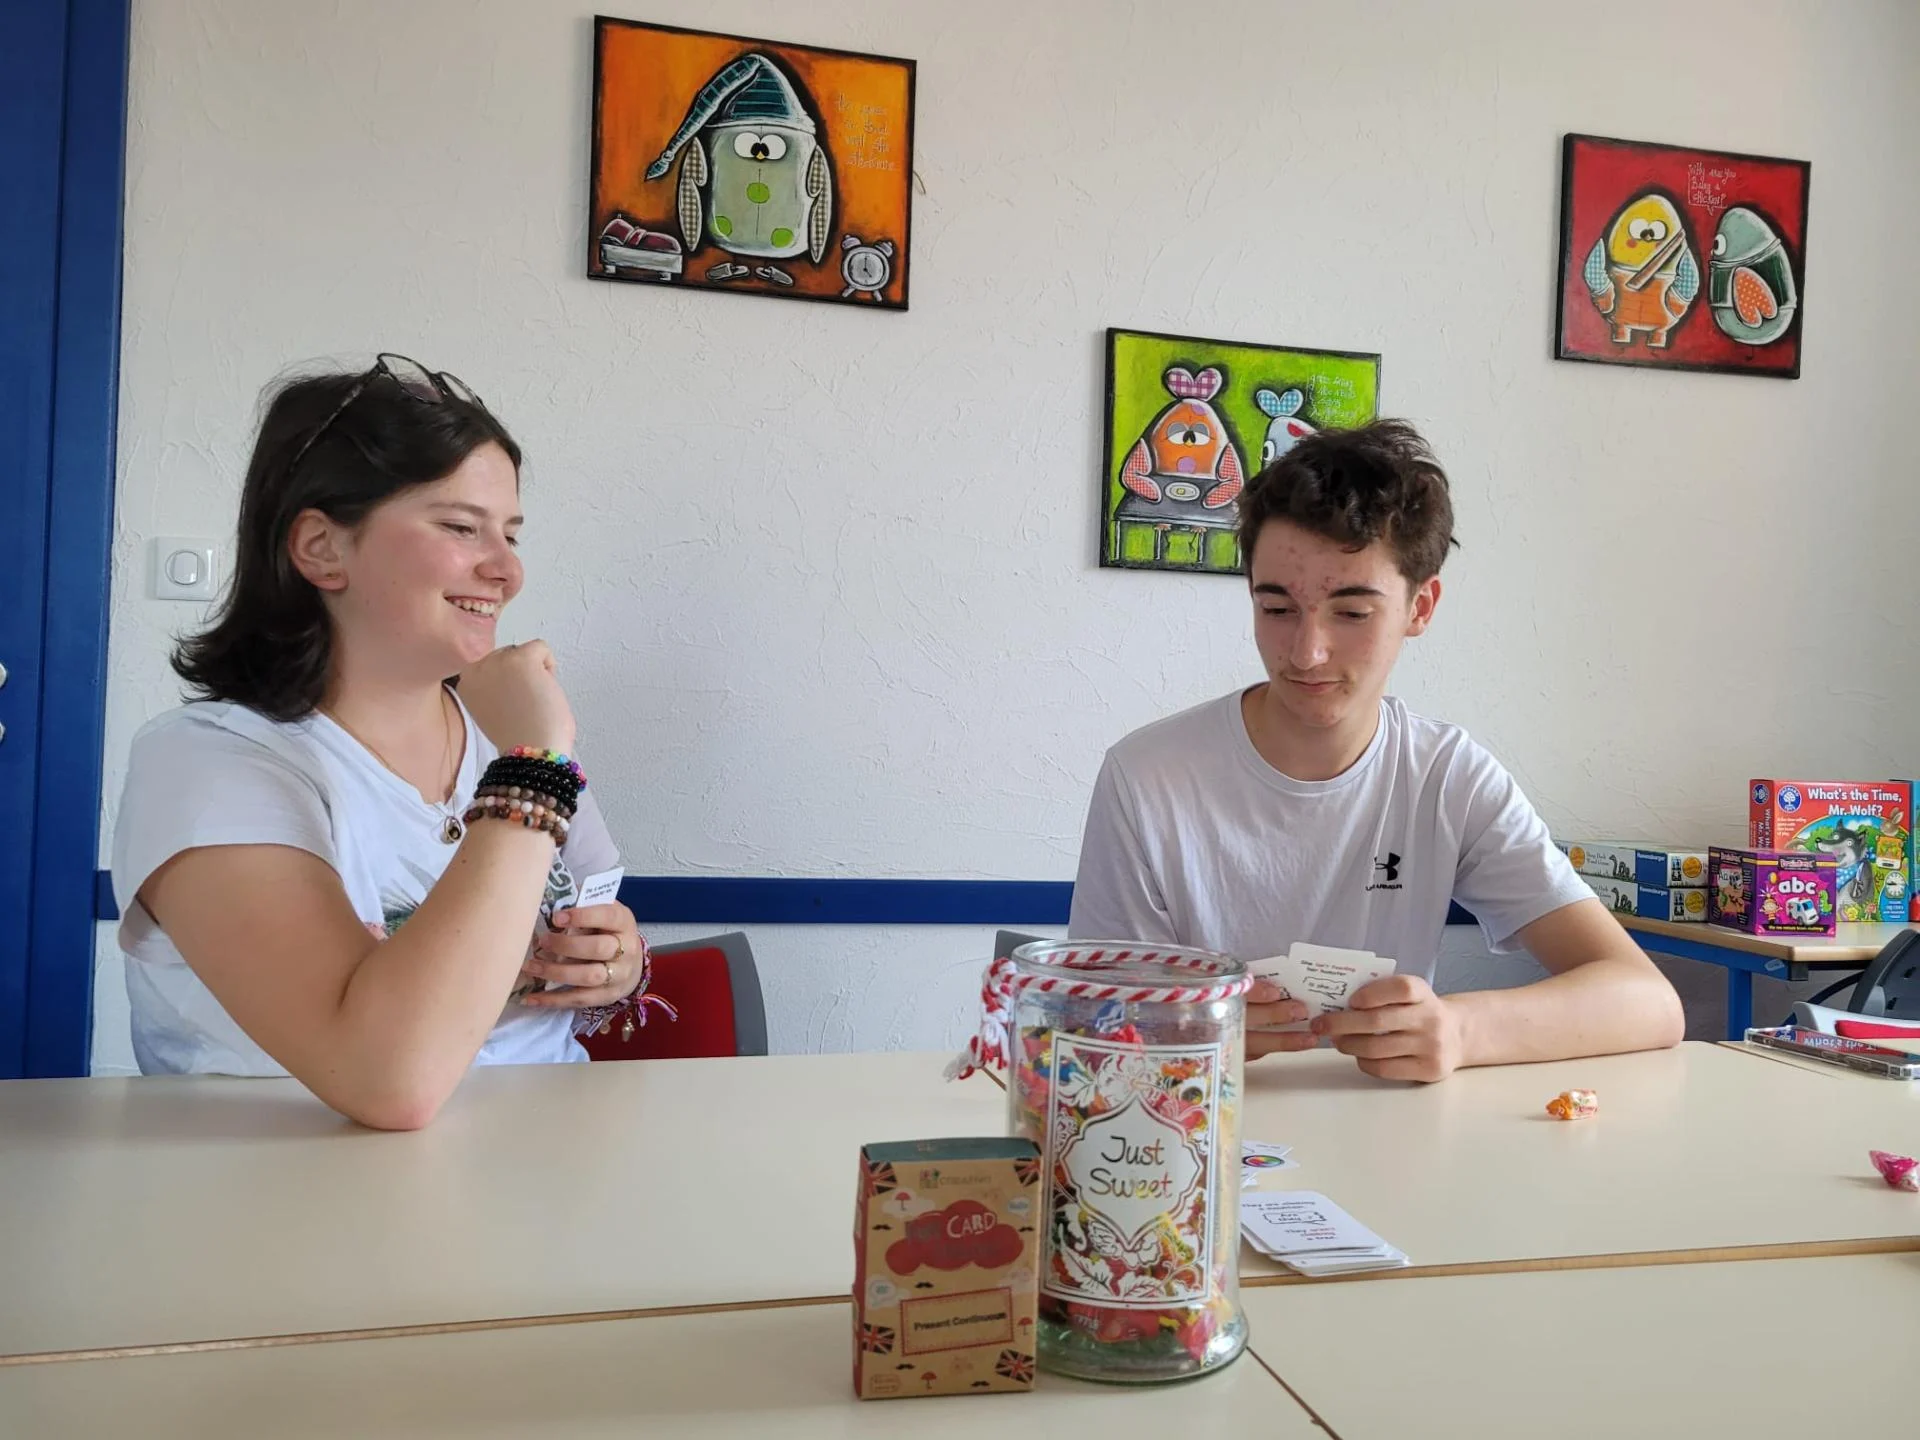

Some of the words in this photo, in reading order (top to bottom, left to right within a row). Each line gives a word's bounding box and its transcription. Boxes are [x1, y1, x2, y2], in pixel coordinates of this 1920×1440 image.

[1807, 788, 1848, 801] What's
[1850, 788, 1870, 801] the
[1872, 789, 1902, 802] Time,
[1828, 805, 1846, 815] Mr.
[1849, 805, 1884, 816] Wolf?
[1778, 876, 1817, 895] abc
[1100, 1135, 1165, 1165] Just
[1089, 1168, 1173, 1198] Sweet
[946, 1212, 996, 1238] CARD
[914, 1319, 950, 1331] Present
